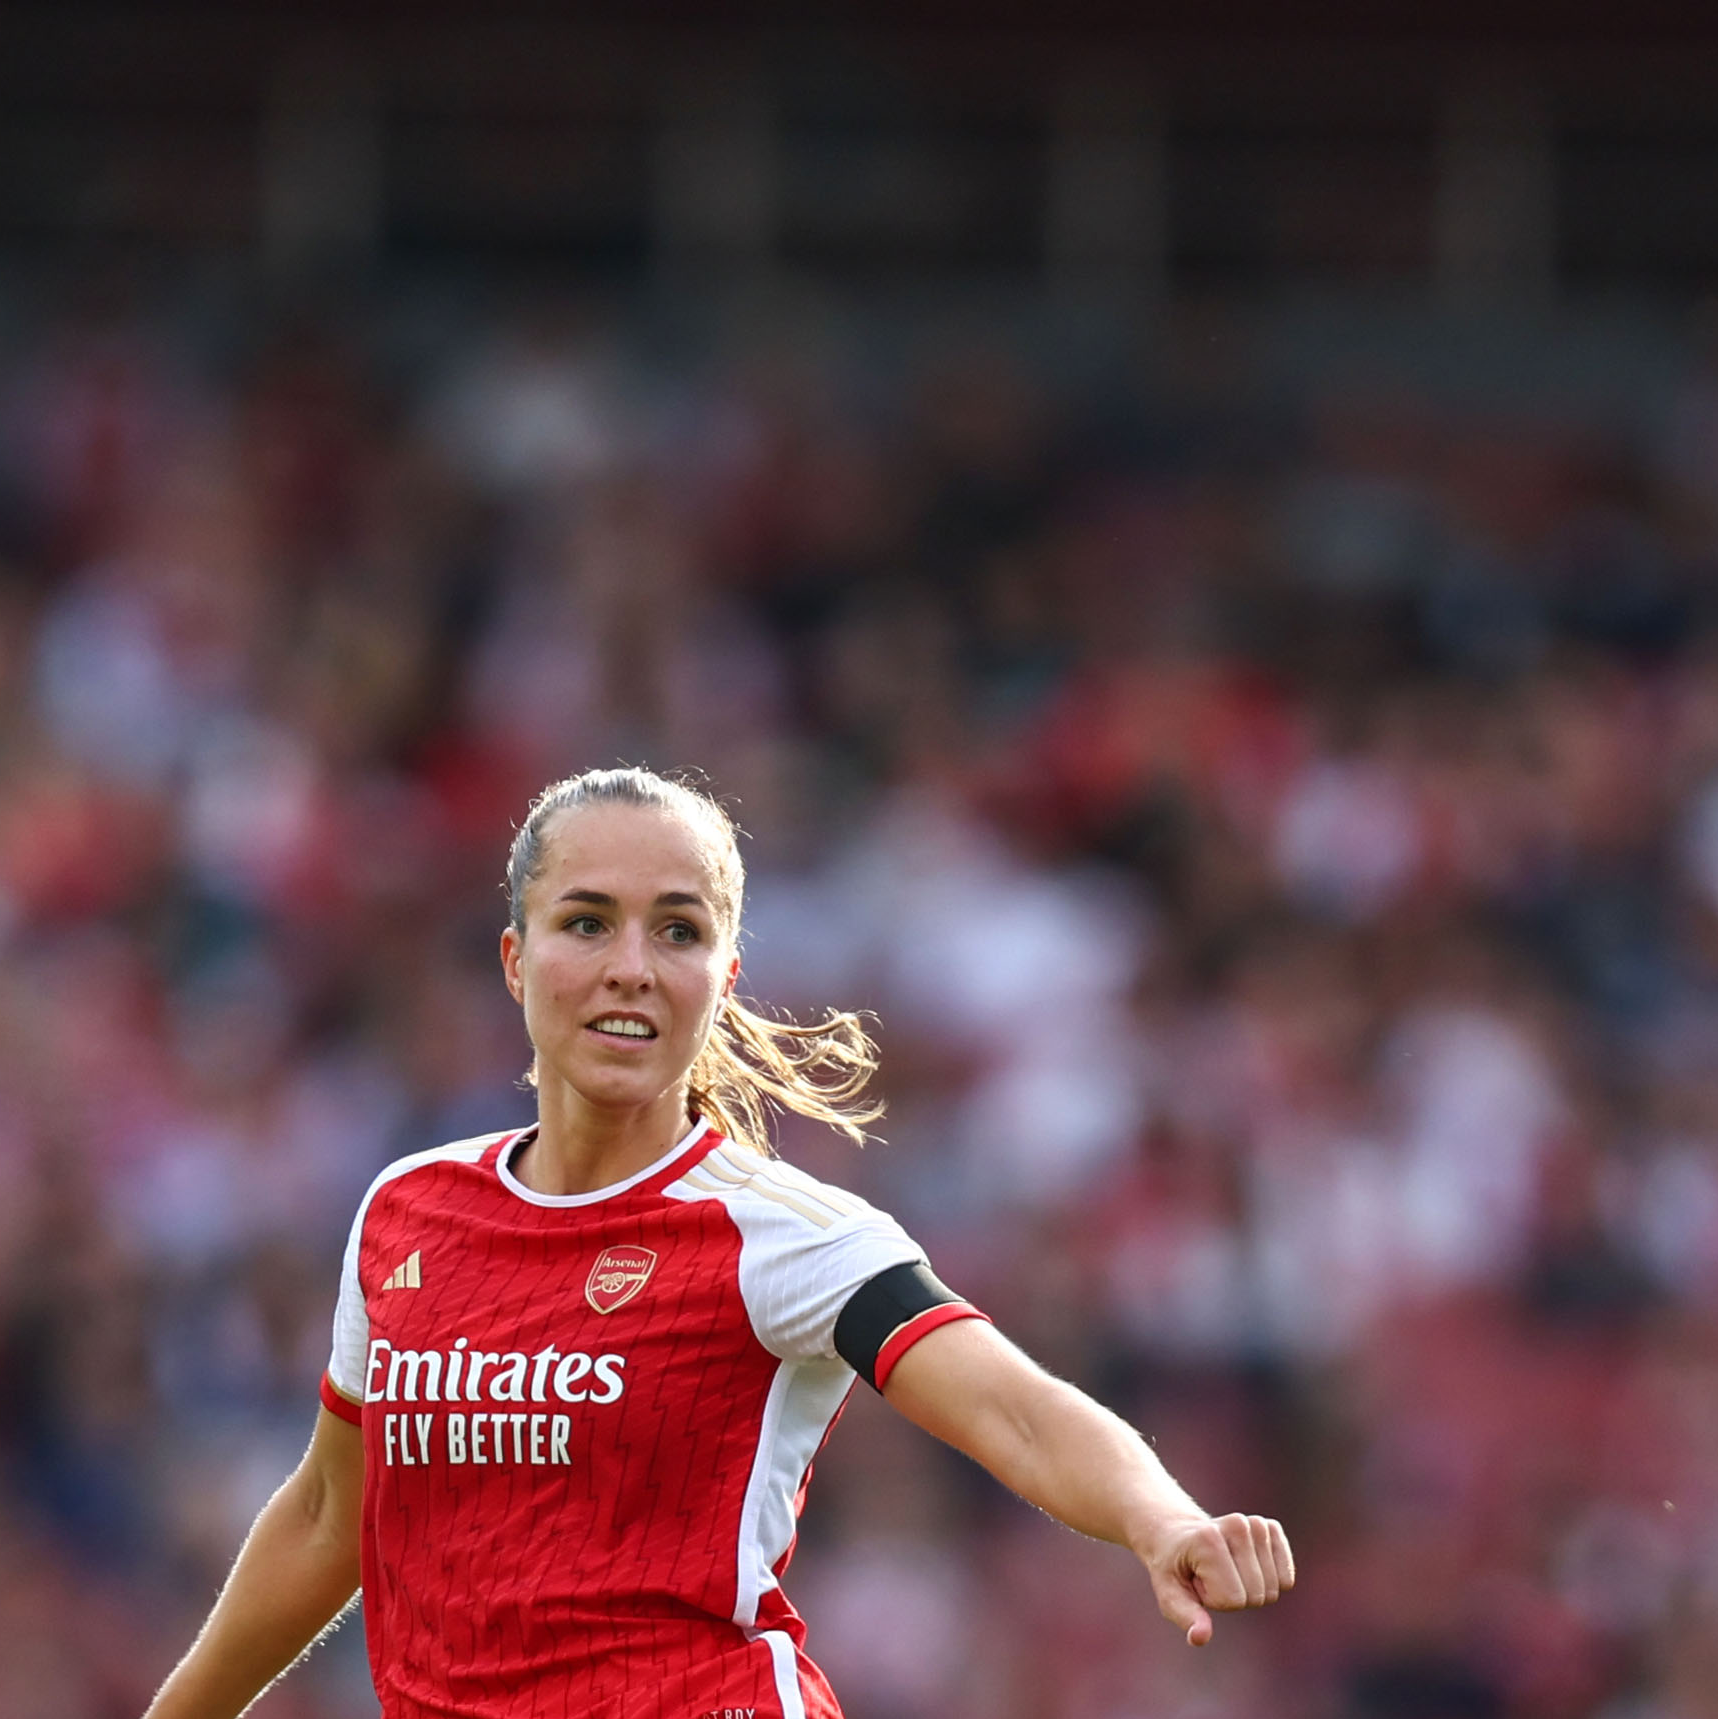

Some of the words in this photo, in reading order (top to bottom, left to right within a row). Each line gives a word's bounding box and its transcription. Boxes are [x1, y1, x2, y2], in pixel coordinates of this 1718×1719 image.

[601, 1257, 647, 1269] Arsenal
[364, 1336, 626, 1405] Emirates
[384, 1413, 433, 1466] FLY
[447, 1413, 572, 1465] BETTER
